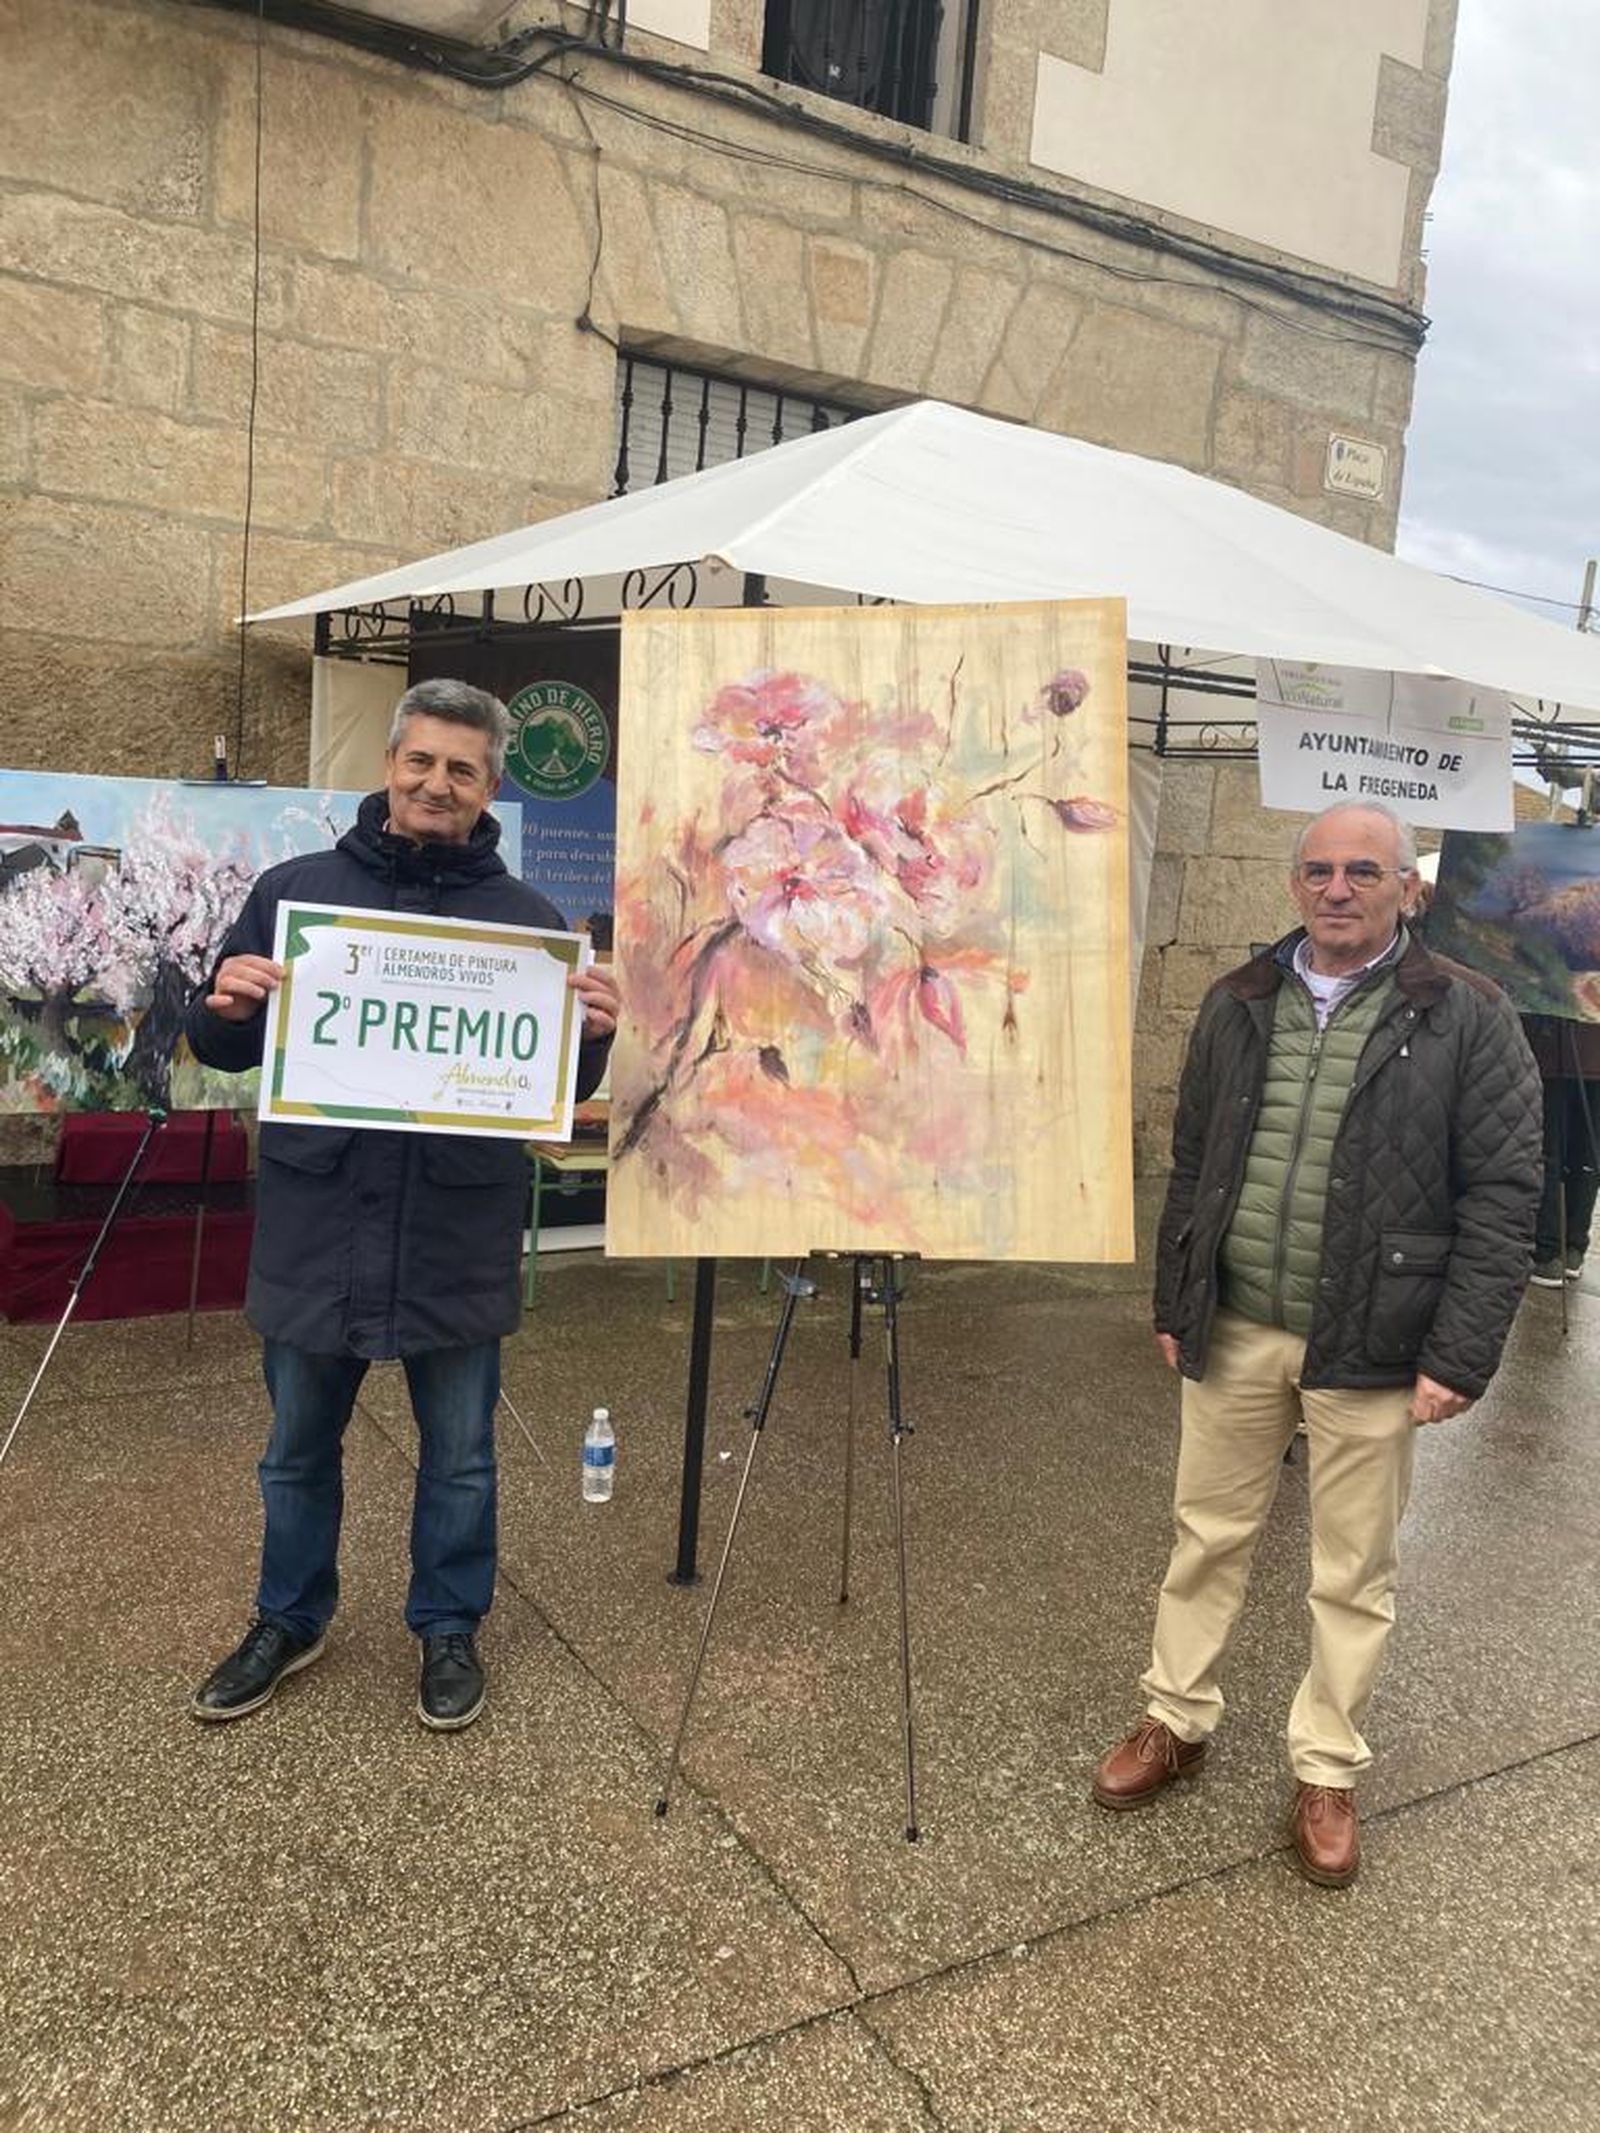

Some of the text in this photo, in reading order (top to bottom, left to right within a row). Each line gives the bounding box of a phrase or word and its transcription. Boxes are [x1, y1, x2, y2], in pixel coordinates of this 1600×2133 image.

[547, 688, 570, 705] DE
[572, 697, 604, 765] HIERRO
[1299, 731, 1464, 772] AYUNTAMIENTO DE
[1321, 771, 1440, 801] LA FREGENEDA
[383, 946, 447, 966] CERTAMEN
[449, 953, 465, 968] DE
[468, 955, 518, 974] PINTURA
[383, 962, 495, 986] ALMENDROS VIVOS
[357, 998, 540, 1062] PREMIO
